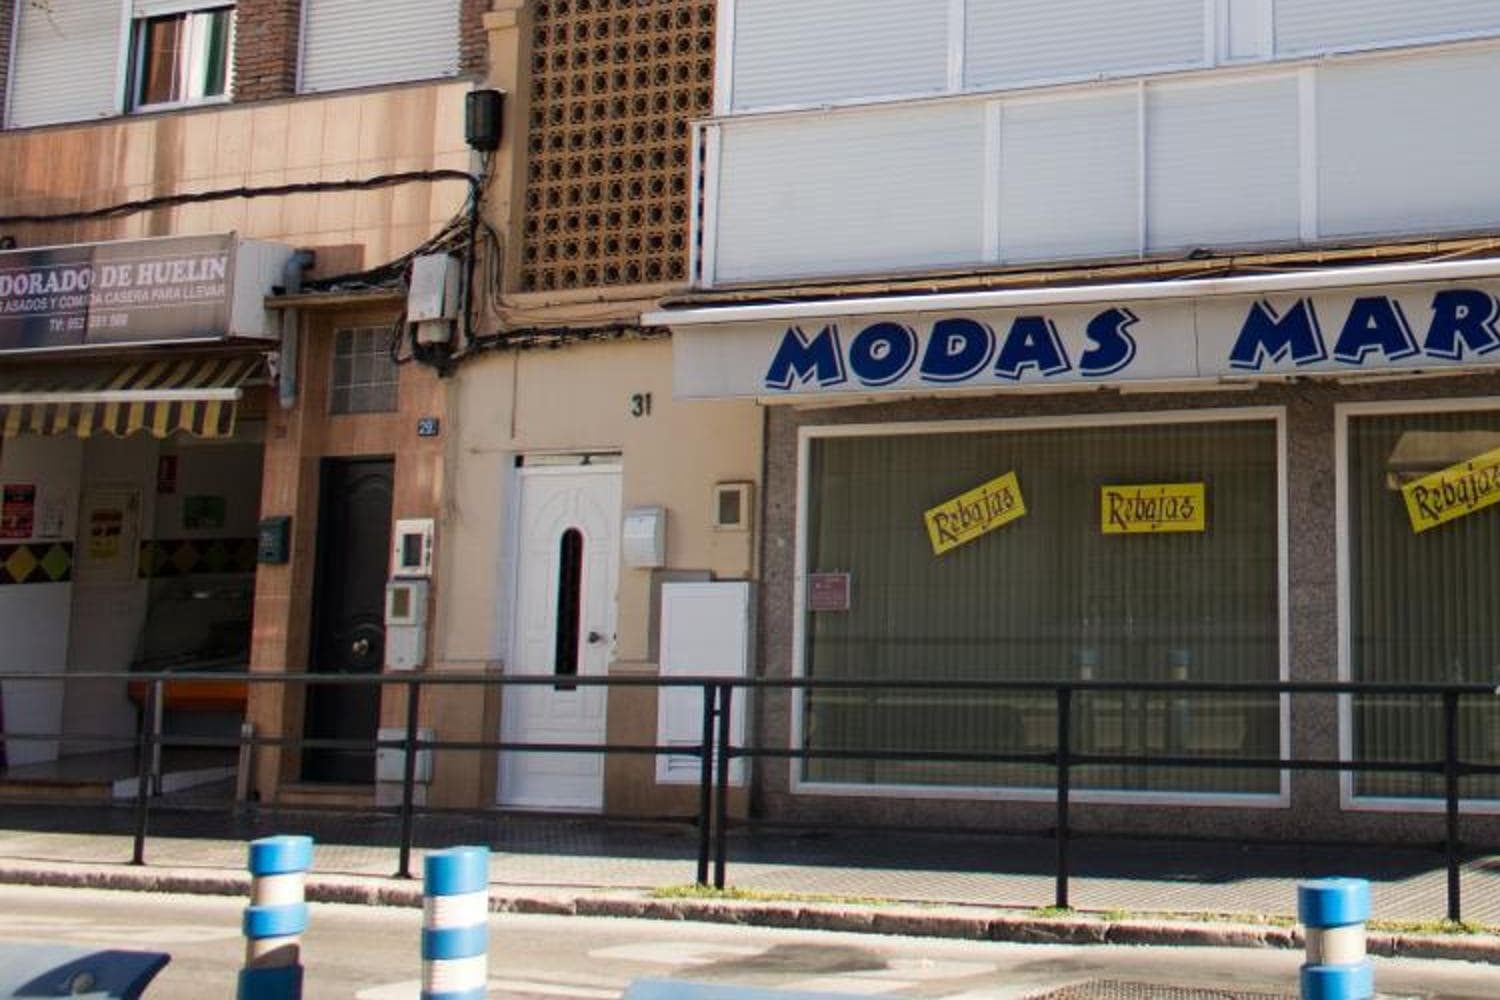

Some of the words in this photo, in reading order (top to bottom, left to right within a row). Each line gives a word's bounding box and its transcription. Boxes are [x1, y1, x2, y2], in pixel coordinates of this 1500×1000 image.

[99, 263, 132, 288] DE
[136, 256, 228, 286] HUELIN
[766, 307, 1140, 390] MODAS
[631, 393, 652, 418] 31
[932, 488, 1015, 544] Rebajas
[1106, 488, 1195, 530] Rebajas
